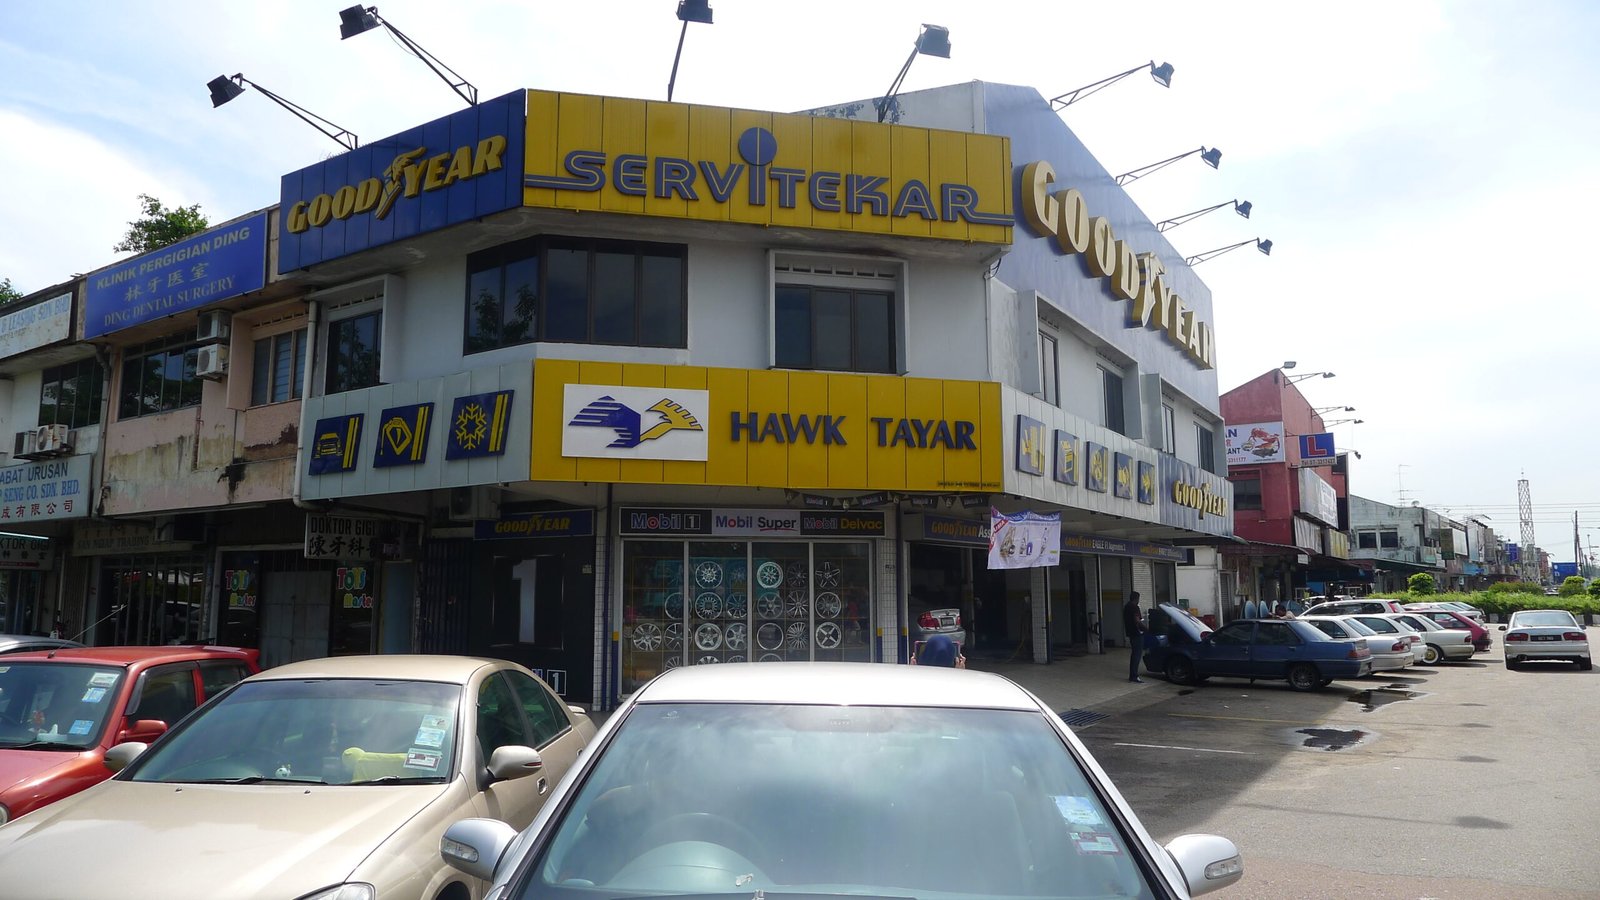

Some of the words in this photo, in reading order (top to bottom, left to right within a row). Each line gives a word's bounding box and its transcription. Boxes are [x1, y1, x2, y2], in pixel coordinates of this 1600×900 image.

[286, 135, 507, 234] GOODYEAR
[97, 268, 136, 290] KLINIK
[139, 241, 210, 275] PERGIGIAN
[214, 226, 250, 250] DING
[1021, 160, 1215, 370] GOODYEAR
[104, 308, 130, 326] DING
[133, 295, 175, 318] DENTAL
[177, 276, 235, 305] SURGERY
[730, 411, 847, 446] HAWK
[871, 416, 978, 451] TAYAR
[1307, 436, 1327, 456] L
[28, 462, 68, 481] URUSAN
[26, 485, 38, 499] CO.
[40, 482, 58, 498] SDN.
[61, 480, 80, 496] BHD.
[1, 500, 73, 519] 成有限公司
[1174, 481, 1228, 519] GOODYEAR
[311, 517, 352, 535] DOKTOR
[355, 519, 376, 536] GIGI
[495, 515, 571, 535] GOODYEAR
[631, 513, 681, 530] Mobil
[715, 515, 753, 528] Mobil
[757, 516, 797, 531] Super
[804, 518, 838, 530] Mobil
[841, 518, 883, 530] Delvac
[931, 520, 977, 537] GOODYEAR
[978, 528, 991, 538] Ass
